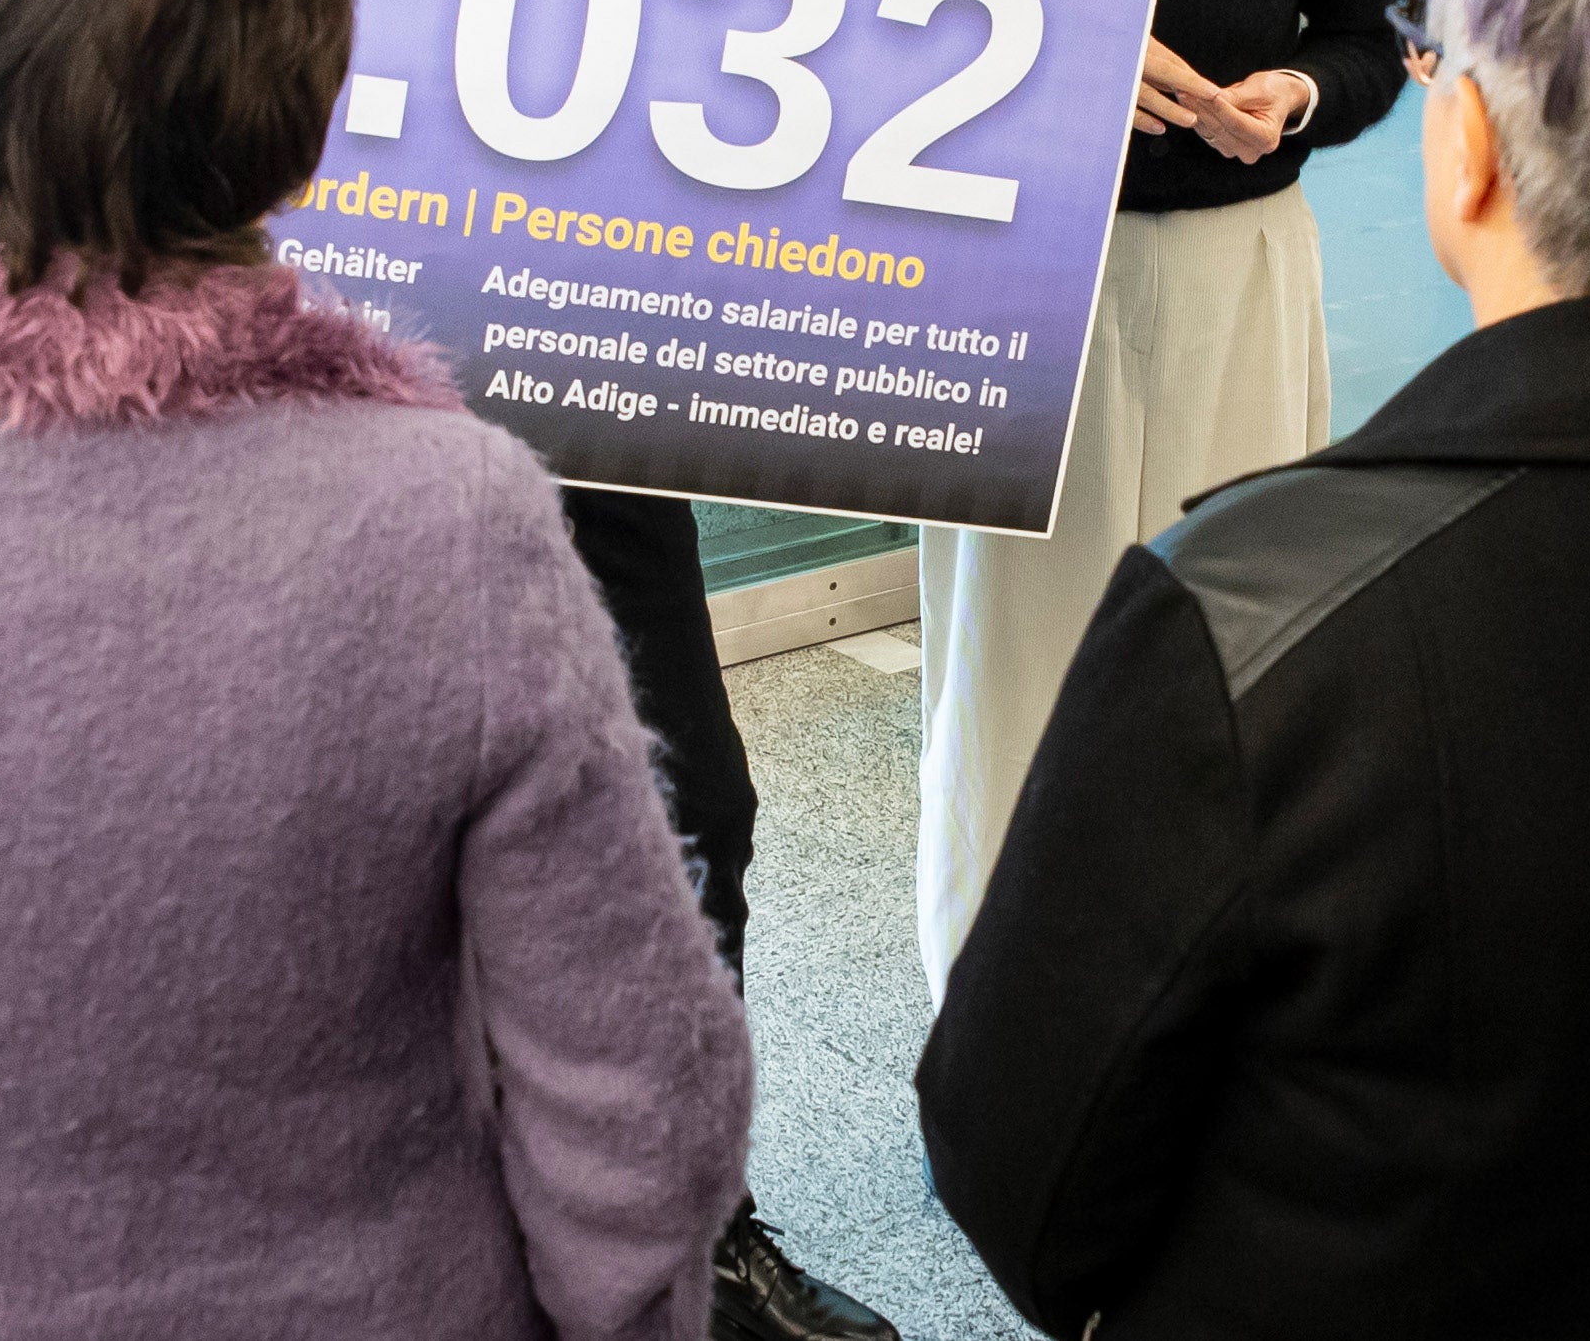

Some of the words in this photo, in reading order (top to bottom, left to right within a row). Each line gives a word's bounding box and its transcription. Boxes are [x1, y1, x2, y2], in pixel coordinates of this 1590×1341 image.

[277, 238, 423, 284] Gehälter
[491, 191, 694, 258] Persone
[707, 221, 925, 288] chiedono
[480, 265, 713, 321] Adeguamento
[721, 298, 858, 339] salariale
[864, 320, 919, 349] per
[926, 323, 1000, 357] tutto
[1008, 331, 1029, 361] il
[483, 322, 648, 364] personale
[656, 337, 707, 372] del
[714, 351, 828, 387] settore
[834, 364, 971, 404] pubblico
[978, 377, 1008, 409] in
[485, 369, 554, 405] Alto
[561, 378, 658, 422] Adige
[689, 392, 859, 441] immediato
[867, 421, 887, 444] e
[894, 422, 983, 455] reale!
